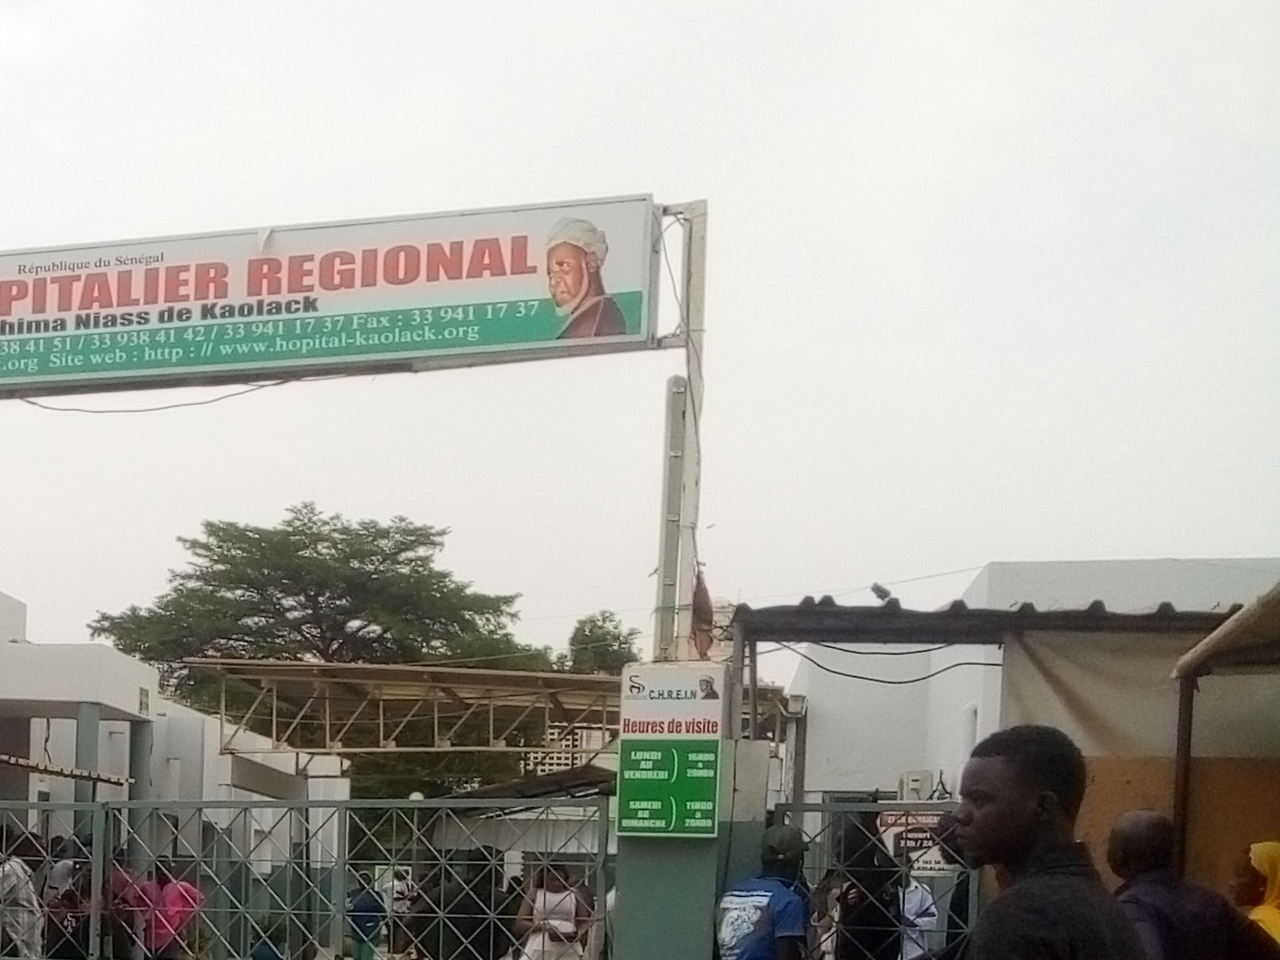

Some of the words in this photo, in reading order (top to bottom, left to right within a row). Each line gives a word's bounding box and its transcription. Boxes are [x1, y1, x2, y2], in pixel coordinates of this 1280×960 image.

[17, 258, 91, 276] République
[94, 256, 111, 267] du
[115, 252, 164, 267] Sénégal
[247, 235, 537, 297] REGIONAL
[25, 339, 45, 353] 41
[52, 337, 71, 352] 51
[90, 333, 111, 349] 33
[117, 331, 150, 346] 938
[155, 329, 177, 343] 41
[183, 326, 206, 341] 42
[224, 323, 245, 339] 33
[252, 320, 284, 335] 941
[295, 318, 315, 333] 17
[322, 316, 345, 333] 37
[352, 314, 390, 330] Fax
[410, 309, 433, 325] 33
[440, 306, 475, 322] 941
[485, 303, 507, 319] 17
[515, 300, 540, 317] 37
[75, 310, 151, 330] Niass
[158, 306, 192, 324] de
[201, 296, 320, 320] Kaolack
[49, 352, 84, 367] Site
[90, 349, 127, 364] web
[144, 346, 183, 362] http
[220, 325, 480, 355] www.hopital-kaolack.org
[622, 717, 665, 734] Heures
[667, 718, 682, 734] de
[685, 717, 718, 734] visite
[630, 751, 662, 760] LUNDI
[623, 770, 668, 779] VENDREDI
